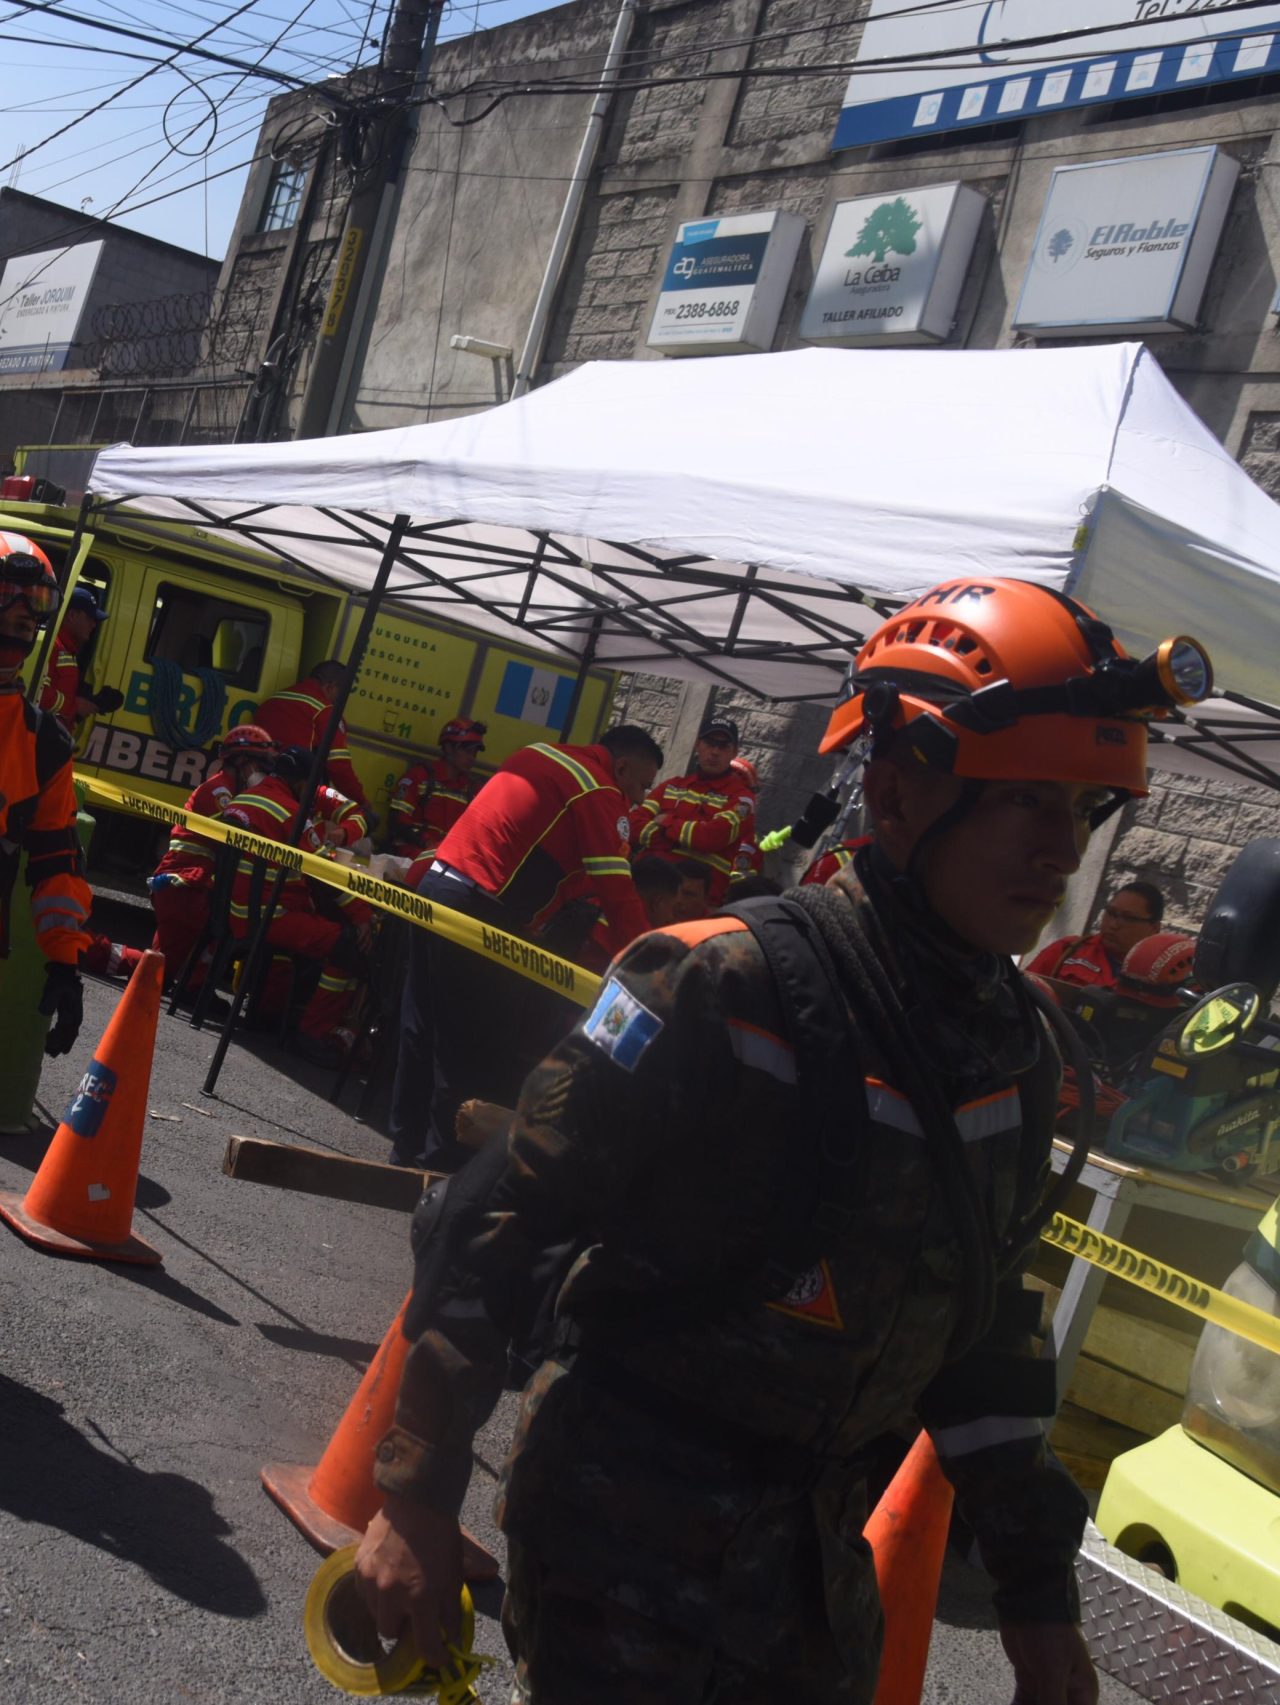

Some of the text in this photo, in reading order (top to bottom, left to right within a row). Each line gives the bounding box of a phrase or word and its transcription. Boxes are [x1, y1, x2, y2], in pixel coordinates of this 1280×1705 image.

[1085, 241, 1181, 260] Seguros y Fianzas
[844, 264, 901, 287] La Ceiba
[676, 300, 740, 320] 2388-6868
[822, 306, 904, 324] TALLER AFILIADO
[374, 627, 437, 652] USQUEDA
[363, 647, 421, 669] ESCATE
[358, 664, 451, 699] STRUCTURAS
